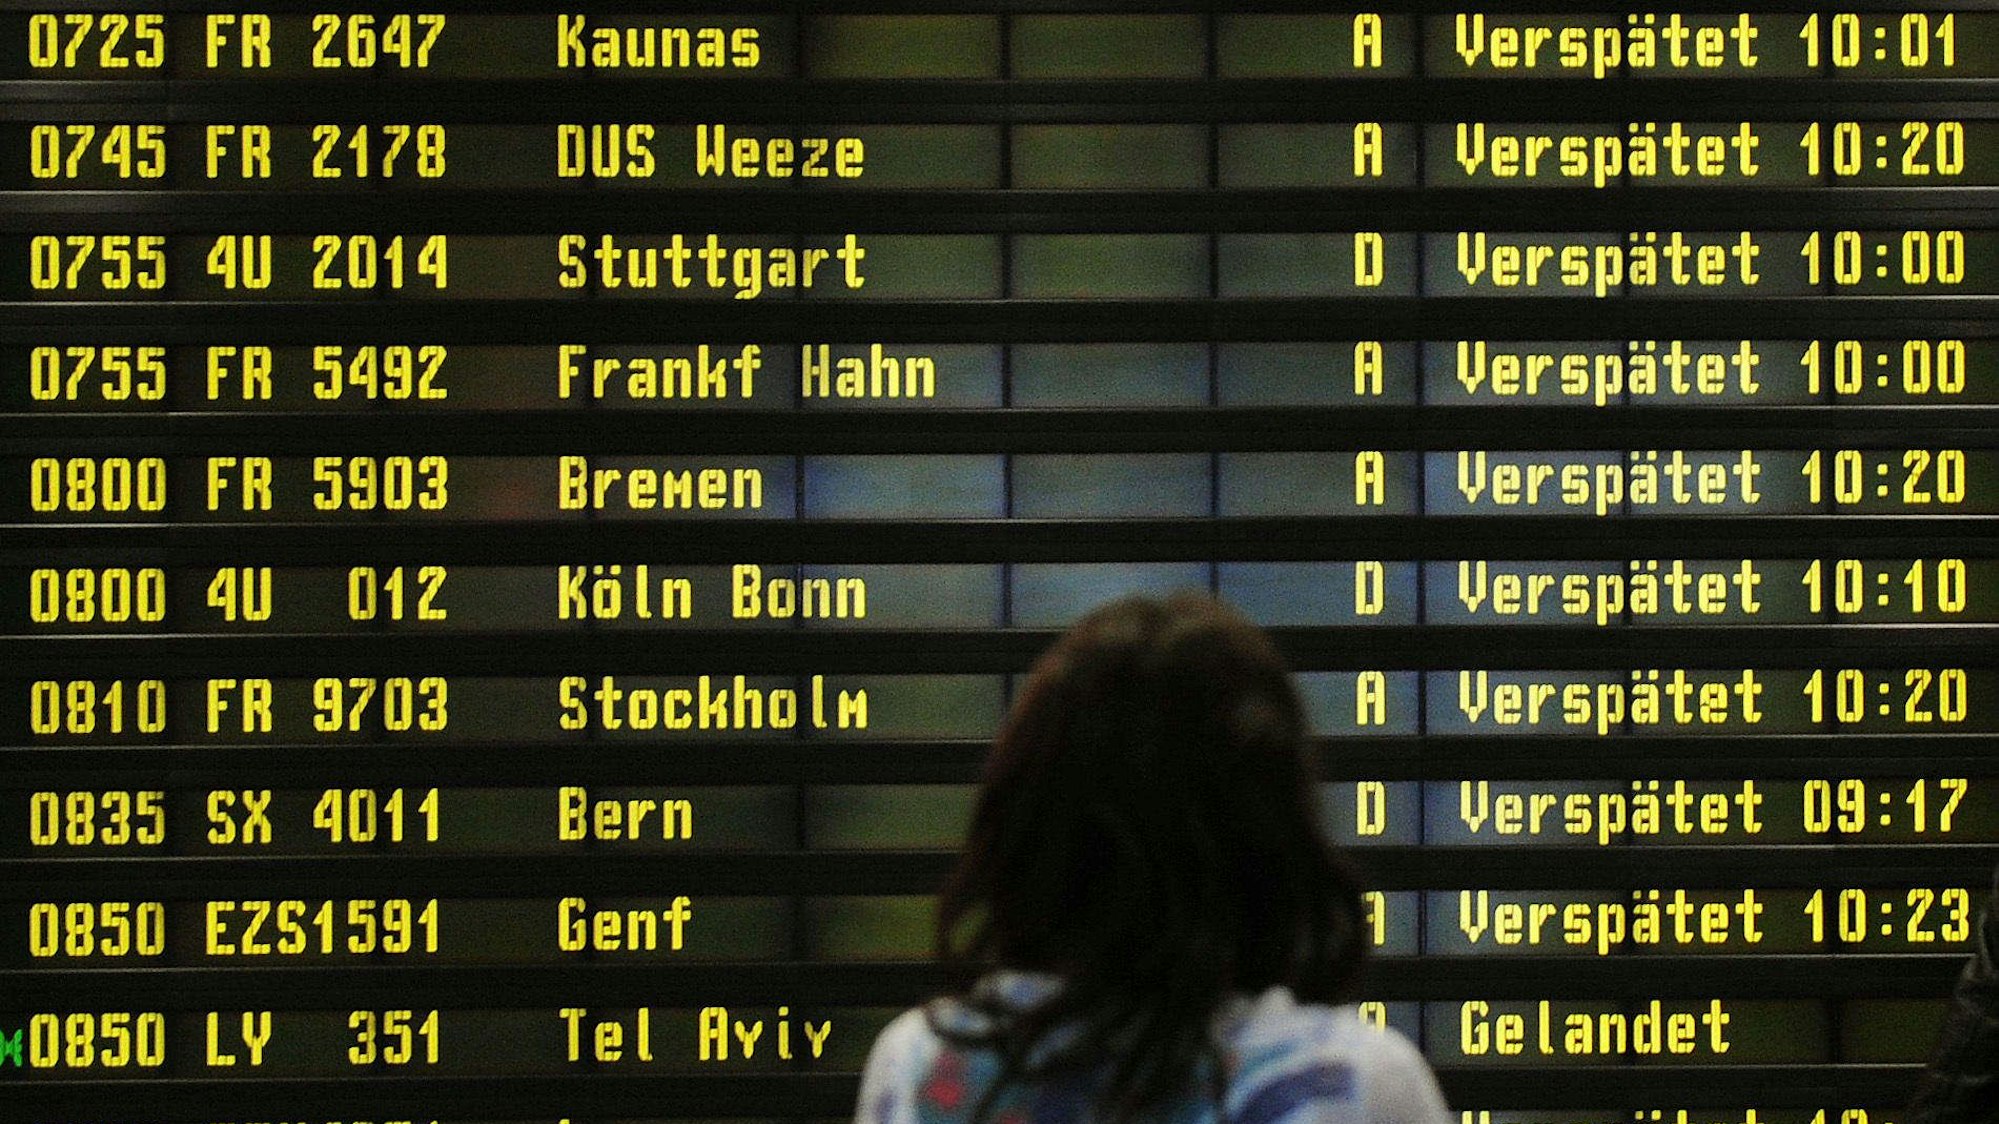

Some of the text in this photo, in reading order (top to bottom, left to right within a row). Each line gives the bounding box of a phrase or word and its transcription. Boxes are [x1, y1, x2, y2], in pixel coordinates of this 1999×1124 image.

[28, 12, 1955, 80] 0725 FR 2647 Kaunas A Verspätet 10:01
[30, 121, 1964, 189] 0745 FR 2178 DUS Weeze A Verspätet 10:20
[30, 230, 1965, 300] 0755 4U 2014 Stuttgart D Verspätet 10:00
[30, 339, 1965, 407] 0755 FR 5492 Frankf Hahn A Verspätet 10:00
[30, 449, 1966, 517] 0800 FR 5903 Bremen A Verspätet 10:20
[30, 558, 1966, 626] 0800 4U 012 Köln Bonn D Verspätet 10:10
[30, 668, 1967, 736] 0810 FR 9703 Stockholm A Verspätet 10:20
[30, 778, 1968, 846] 0835 SX 4011 Bern D Verspätet 09:17
[29, 901, 165, 957] 0850
[558, 896, 692, 952] Genf
[1459, 888, 1764, 956] Verspätet
[1803, 888, 1970, 943] 10:23
[29, 999, 1730, 1068] 0850 LY 351 Tel Aviv Gelandet
